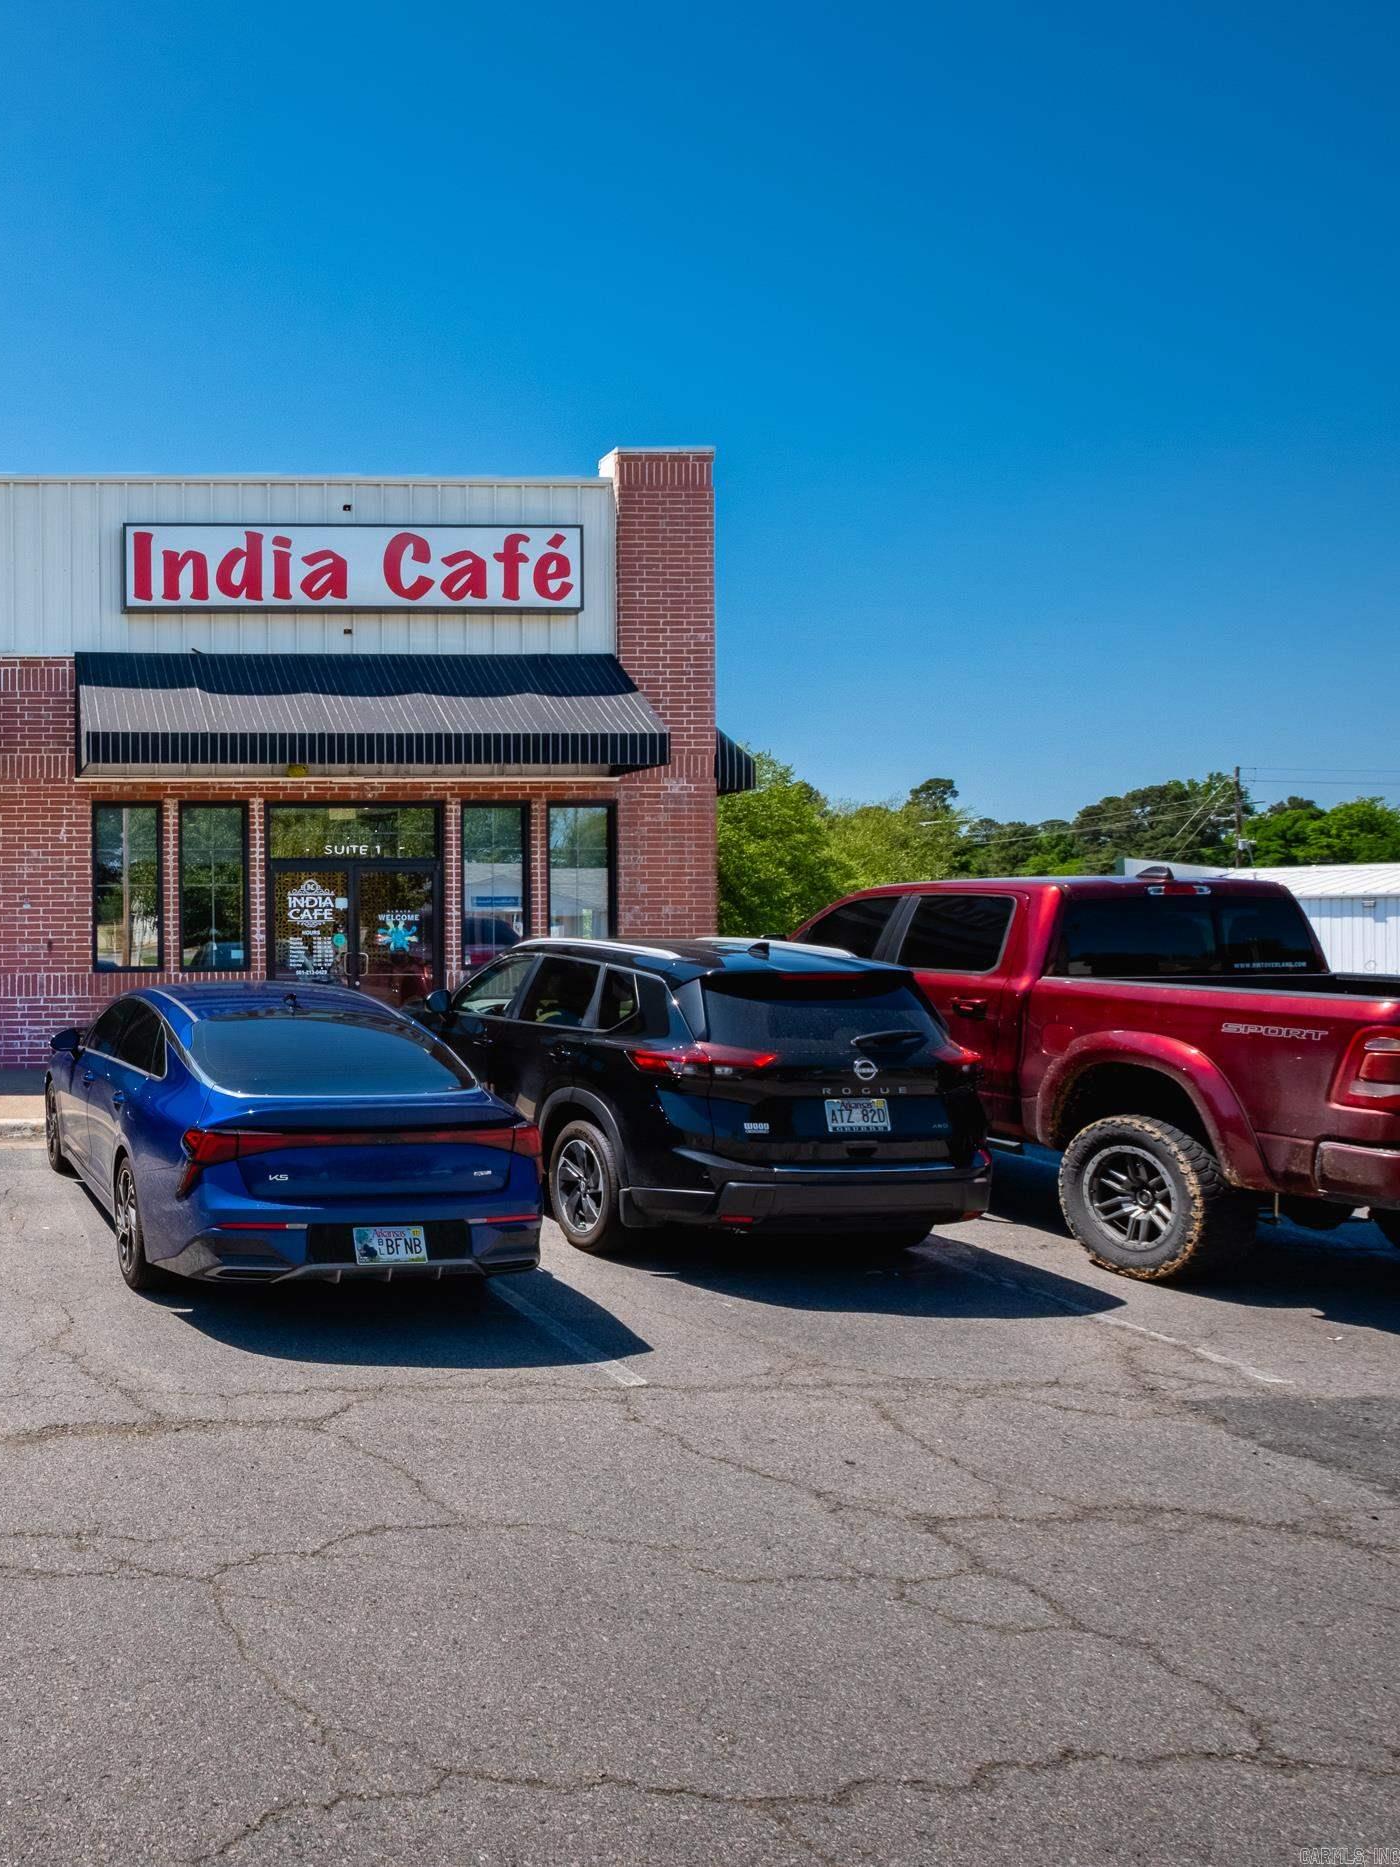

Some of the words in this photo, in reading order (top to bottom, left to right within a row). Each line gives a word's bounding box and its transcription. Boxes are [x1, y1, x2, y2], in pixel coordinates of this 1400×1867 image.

[133, 531, 348, 601] India
[383, 531, 574, 601] Café
[324, 844, 369, 855] SUITE
[375, 845, 380, 855] 1
[287, 896, 334, 908] INDIA
[287, 908, 334, 920] CAFE
[1221, 1022, 1329, 1040] SPORT
[822, 1087, 908, 1095] ROGUE
[831, 1109, 855, 1123] ATZ
[373, 1229, 406, 1238] Arkansas
[386, 1238, 423, 1255] BFNB
